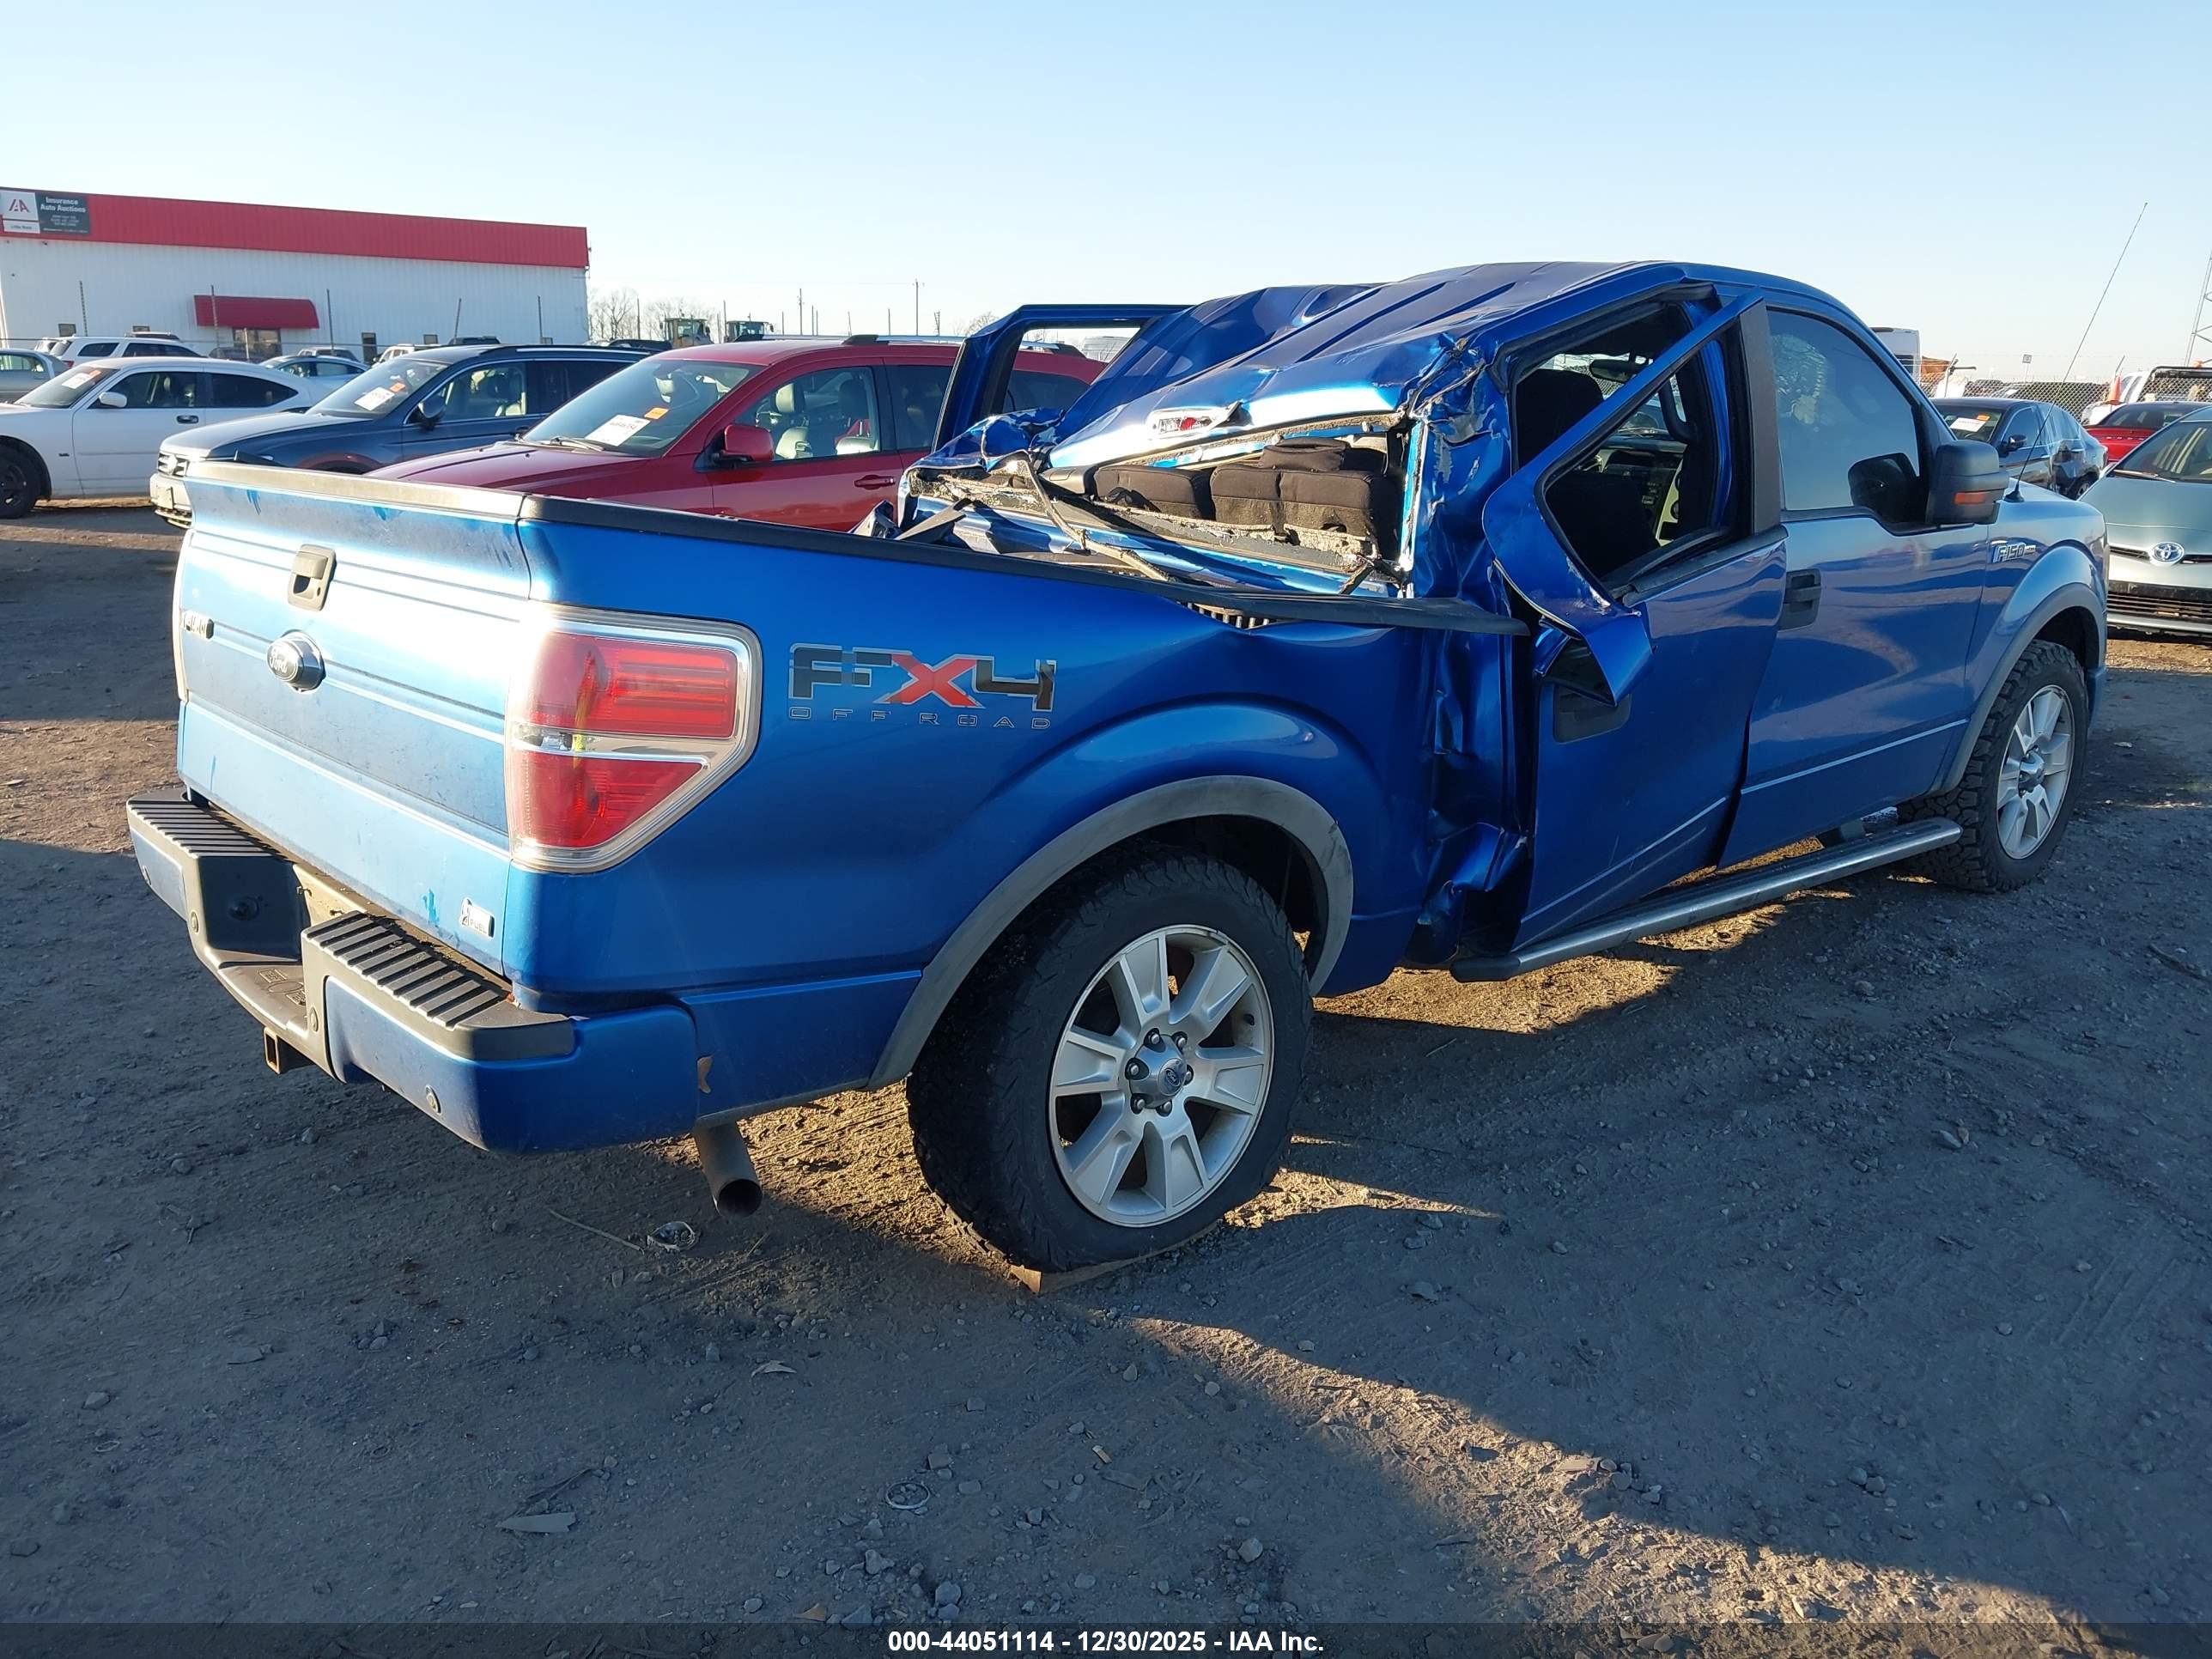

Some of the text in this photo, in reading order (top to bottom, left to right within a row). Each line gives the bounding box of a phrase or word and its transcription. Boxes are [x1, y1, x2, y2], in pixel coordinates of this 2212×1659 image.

[46, 197, 79, 205] Insurance
[57, 204, 86, 213] Auctions
[788, 643, 1058, 711] FX4
